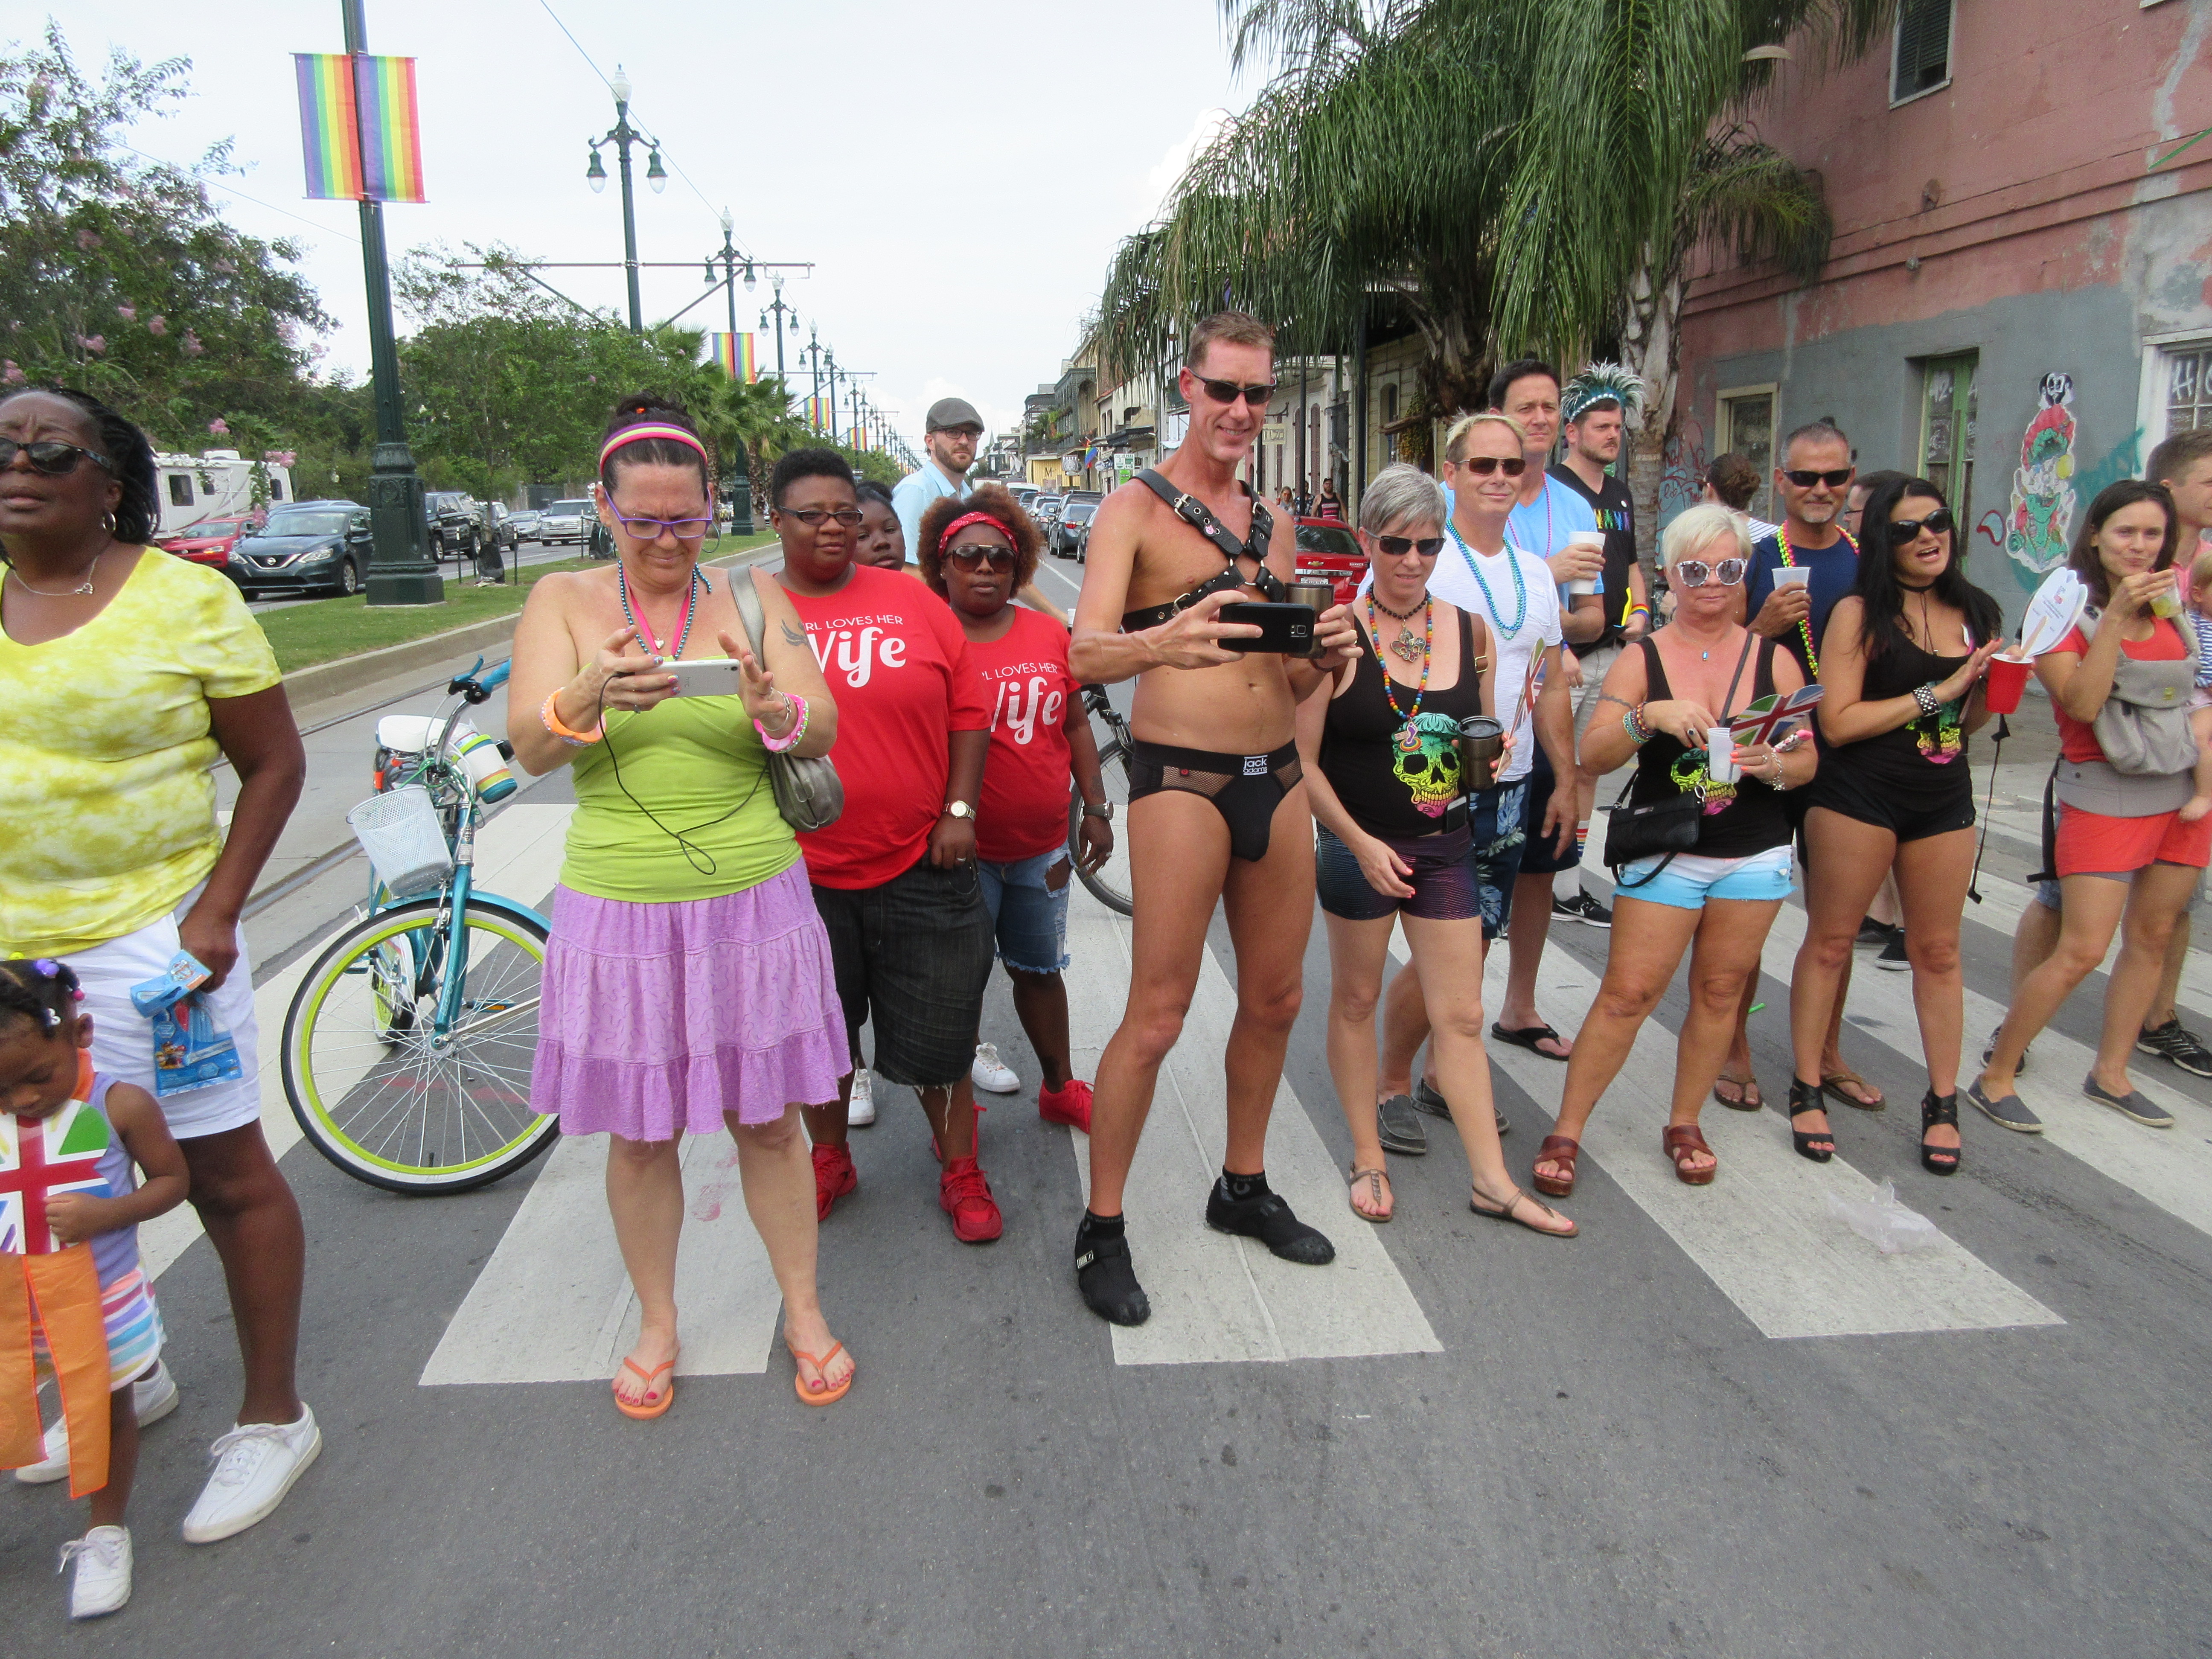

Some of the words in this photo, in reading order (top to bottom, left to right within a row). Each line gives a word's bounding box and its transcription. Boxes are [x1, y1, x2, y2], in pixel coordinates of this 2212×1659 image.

[1045, 467, 1052, 477] M
[803, 623, 822, 631] RL
[826, 616, 873, 629] LOVES
[876, 615, 903, 625] HER
[995, 663, 1037, 678] LOVES
[1039, 662, 1058, 674] HER
[991, 676, 1062, 745] ife
[1243, 758, 1267, 769] jack
